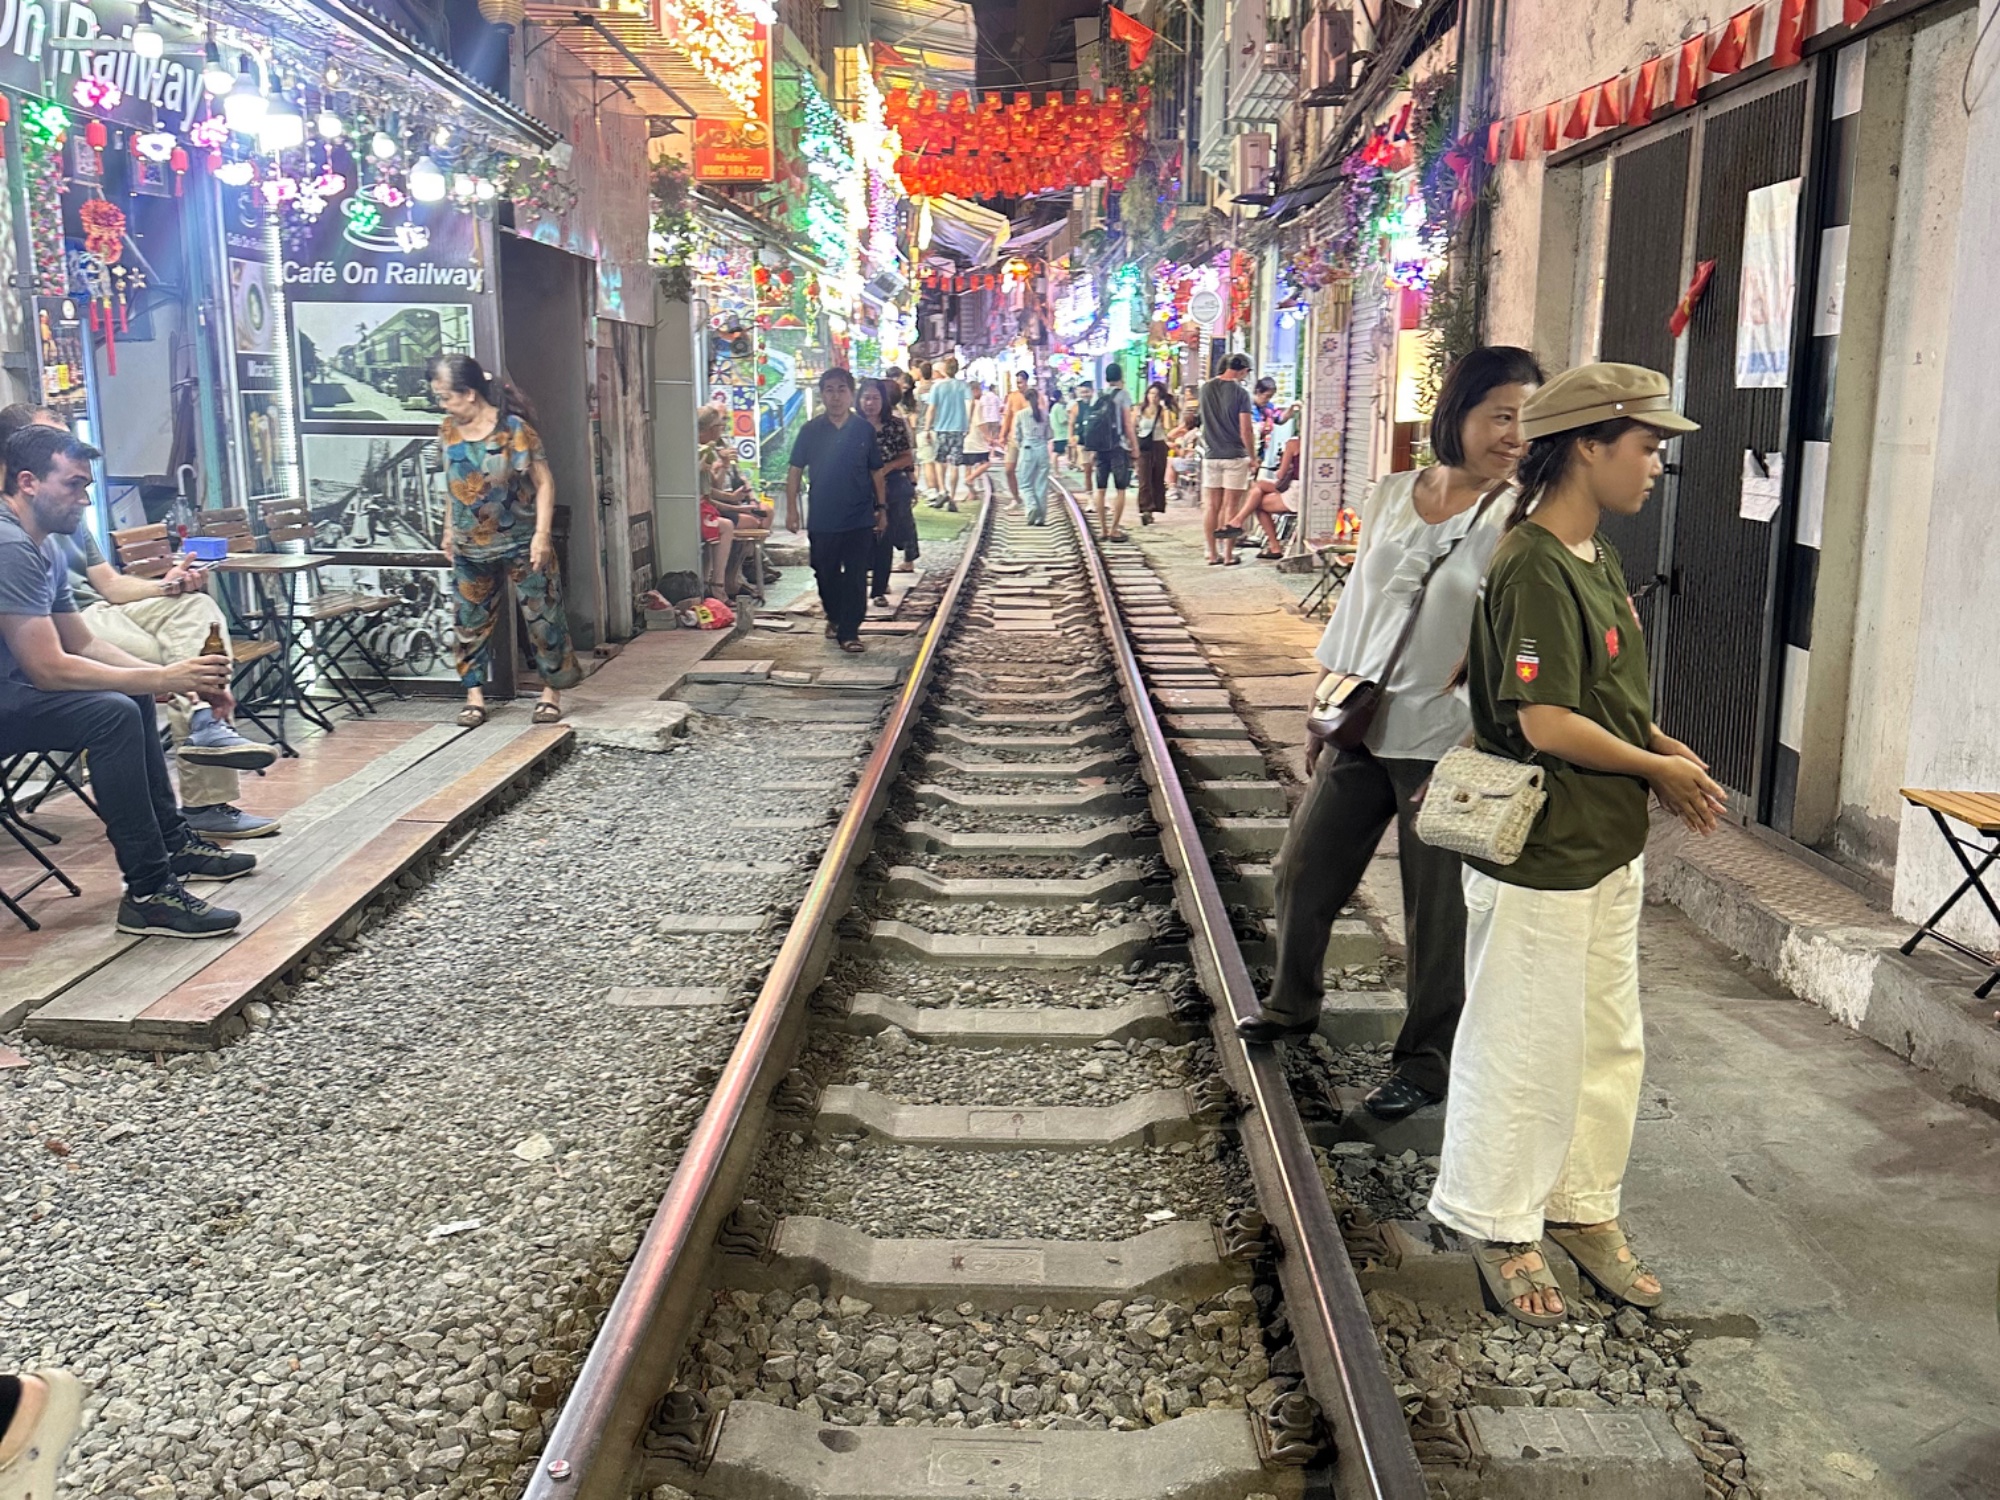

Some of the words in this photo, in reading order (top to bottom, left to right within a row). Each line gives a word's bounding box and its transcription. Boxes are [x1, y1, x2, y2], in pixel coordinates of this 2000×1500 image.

[60, 1, 206, 132] Railway
[283, 261, 337, 284] Café
[342, 261, 379, 284] On
[384, 262, 484, 290] Railway
